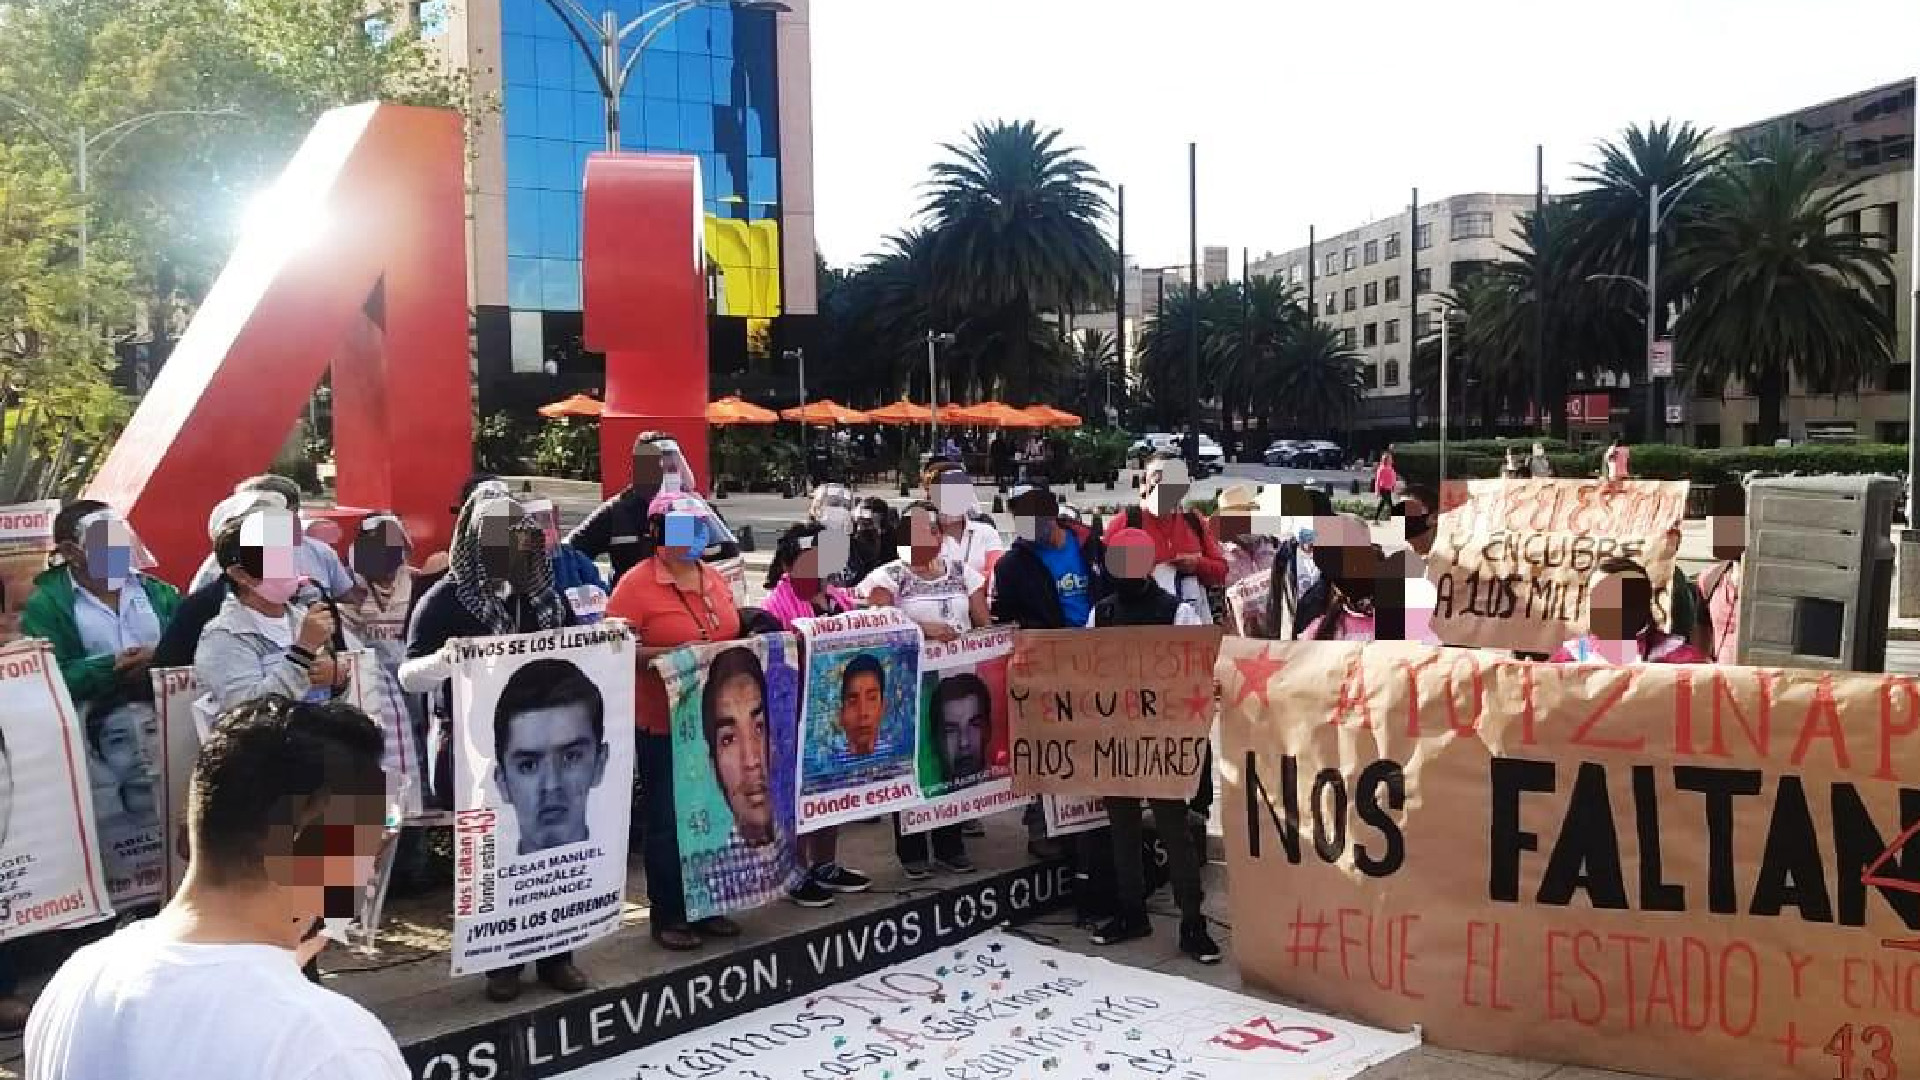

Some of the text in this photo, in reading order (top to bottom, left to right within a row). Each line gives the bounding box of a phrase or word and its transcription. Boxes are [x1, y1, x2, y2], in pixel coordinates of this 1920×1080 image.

[0, 513, 49, 529] aron!
[1433, 573, 1454, 619] A
[508, 639, 526, 655] SE
[530, 634, 555, 653] LOS
[1009, 686, 1030, 720] Y
[1094, 736, 1205, 779] MILITARES
[803, 792, 861, 819] Dónde
[865, 781, 913, 805] están
[907, 810, 932, 827] Con
[1245, 750, 1920, 931] NOS FALTAN
[457, 836, 473, 917] Nos faltan
[497, 847, 605, 879] CÉSAR MANUEL
[514, 864, 588, 891] GONZÁLEZ
[478, 873, 495, 914] Dónde
[508, 877, 593, 908] HERNÁNDEZ
[466, 917, 517, 944] ¡VIVOS
[521, 910, 548, 930] LOS
[525, 952, 793, 1066] LLEVARON,
[807, 909, 922, 975] VIVOS
[934, 887, 998, 936] LOS
[1285, 902, 1425, 1000] #FUE
[1464, 919, 1514, 1011] EL
[1547, 929, 1761, 1039] ESTADO
[1785, 951, 1814, 998] Y
[1209, 1015, 1335, 1054] 43
